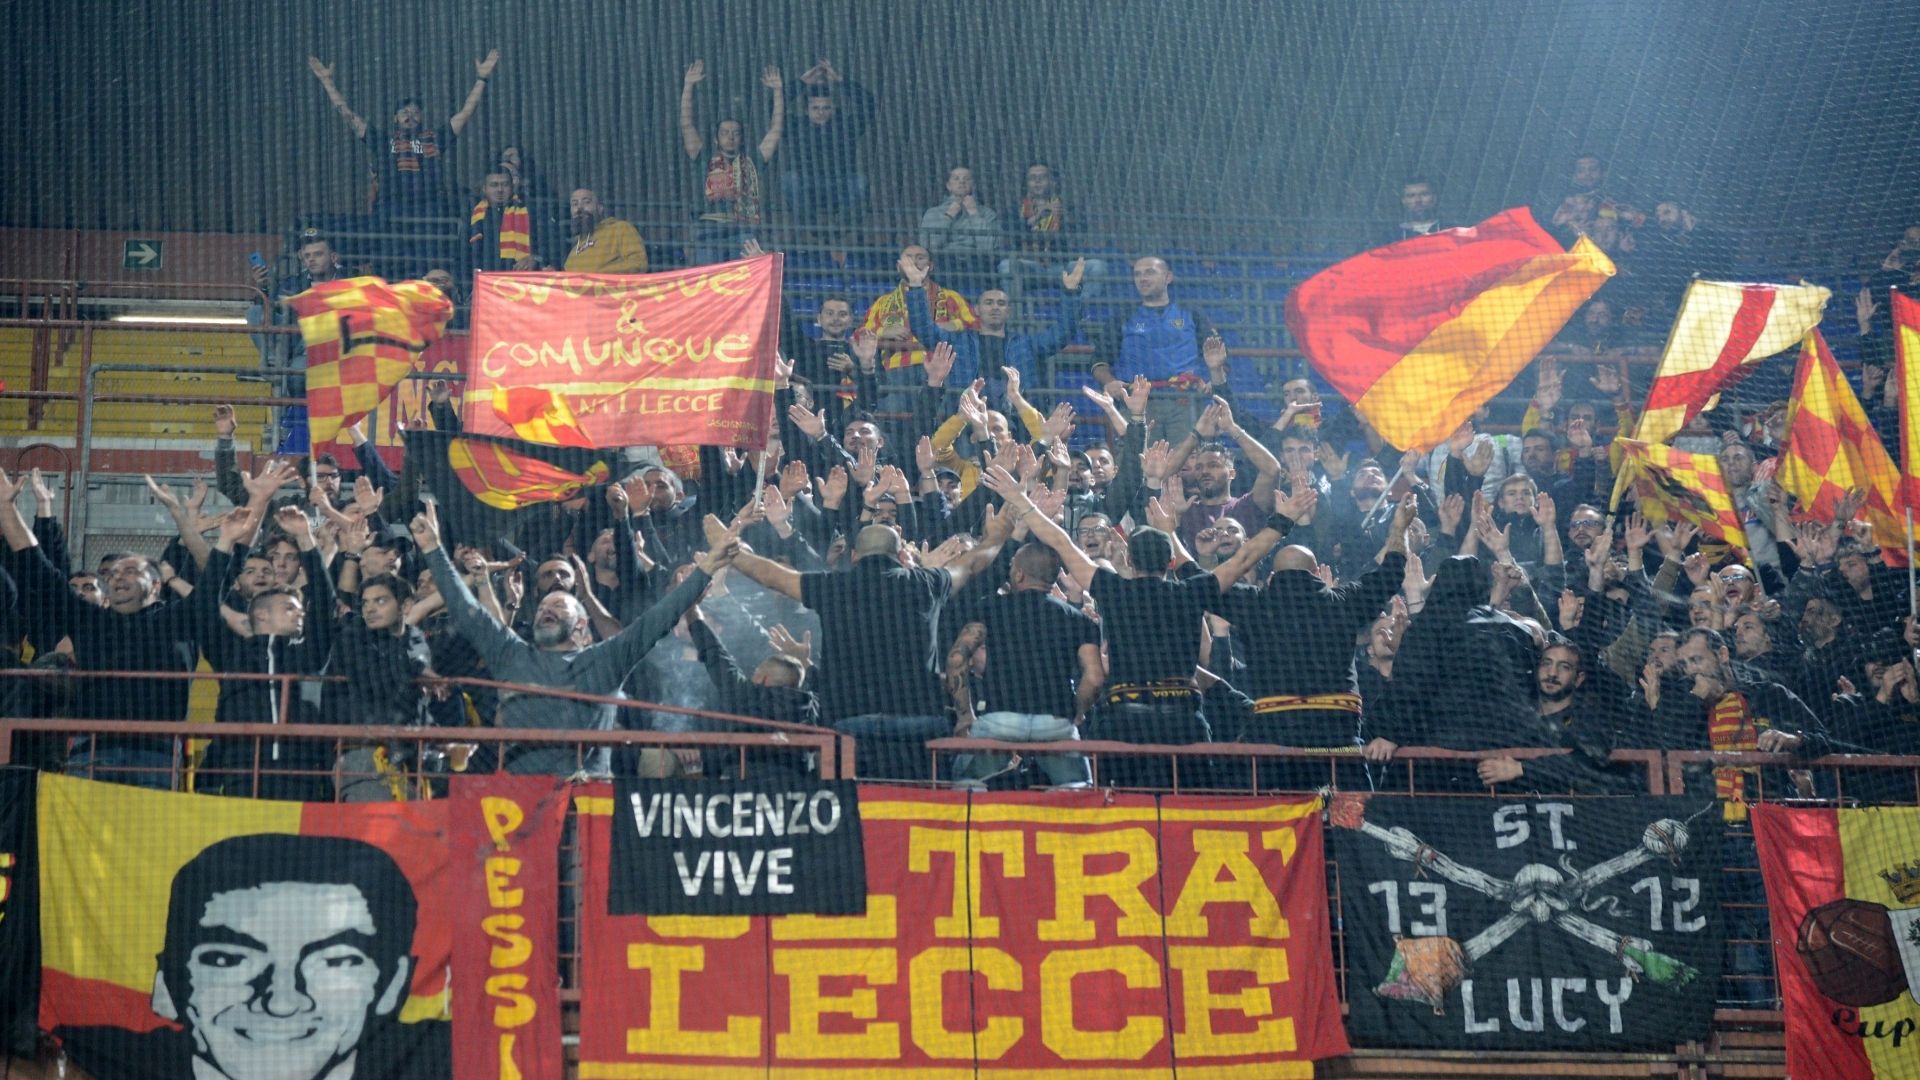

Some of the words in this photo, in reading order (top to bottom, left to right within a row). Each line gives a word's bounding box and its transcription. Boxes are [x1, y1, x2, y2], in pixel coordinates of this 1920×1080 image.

[616, 299, 648, 334] &
[481, 332, 755, 378] COMUNQUE
[639, 393, 724, 415] LECCE
[630, 790, 841, 838] VINCENZO
[1493, 803, 1578, 850] ST.
[647, 826, 1296, 940] TRA'
[673, 848, 794, 896] VIVE
[1369, 880, 1448, 936] 13
[1631, 876, 1706, 932] 12
[626, 944, 1297, 1061] LECCE
[1461, 977, 1632, 1034] LUCY
